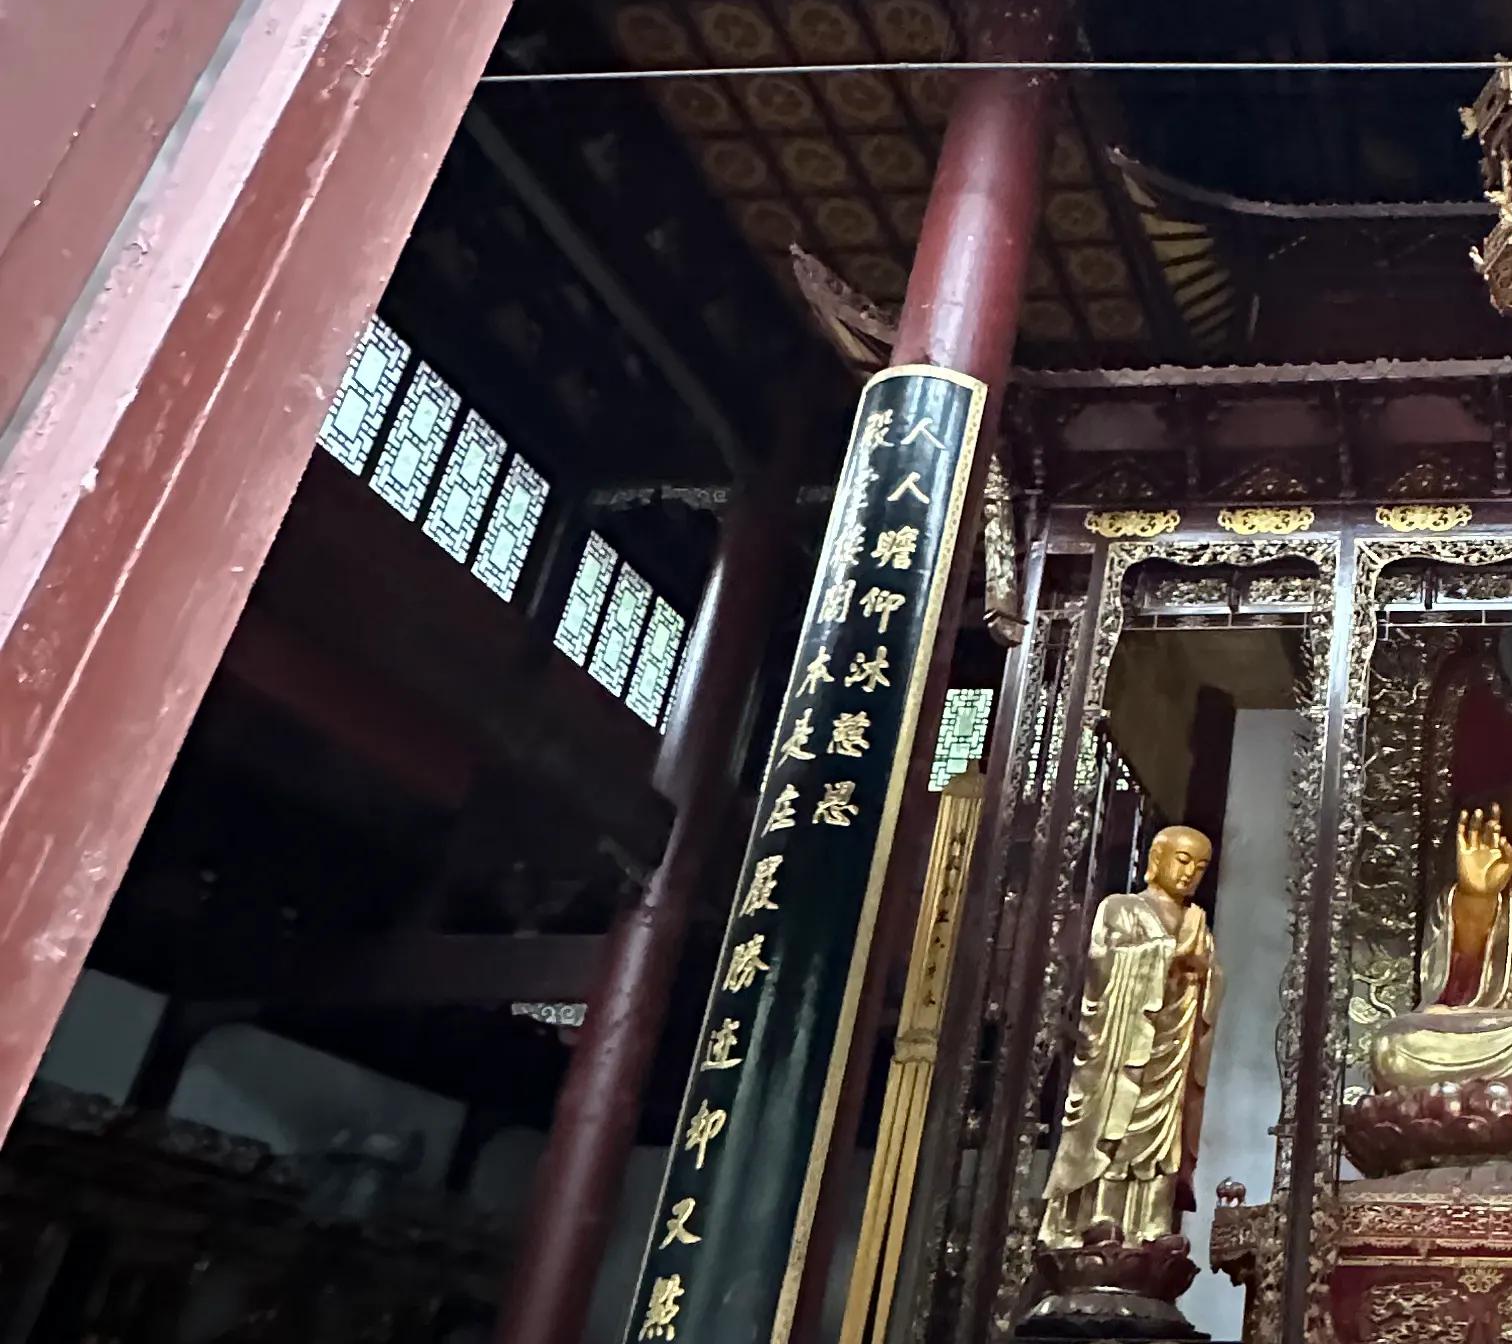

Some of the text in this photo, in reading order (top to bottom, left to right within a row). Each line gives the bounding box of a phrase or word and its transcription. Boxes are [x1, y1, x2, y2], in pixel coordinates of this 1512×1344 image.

[811, 417, 946, 827] 人人瞻仰沐慈恩
